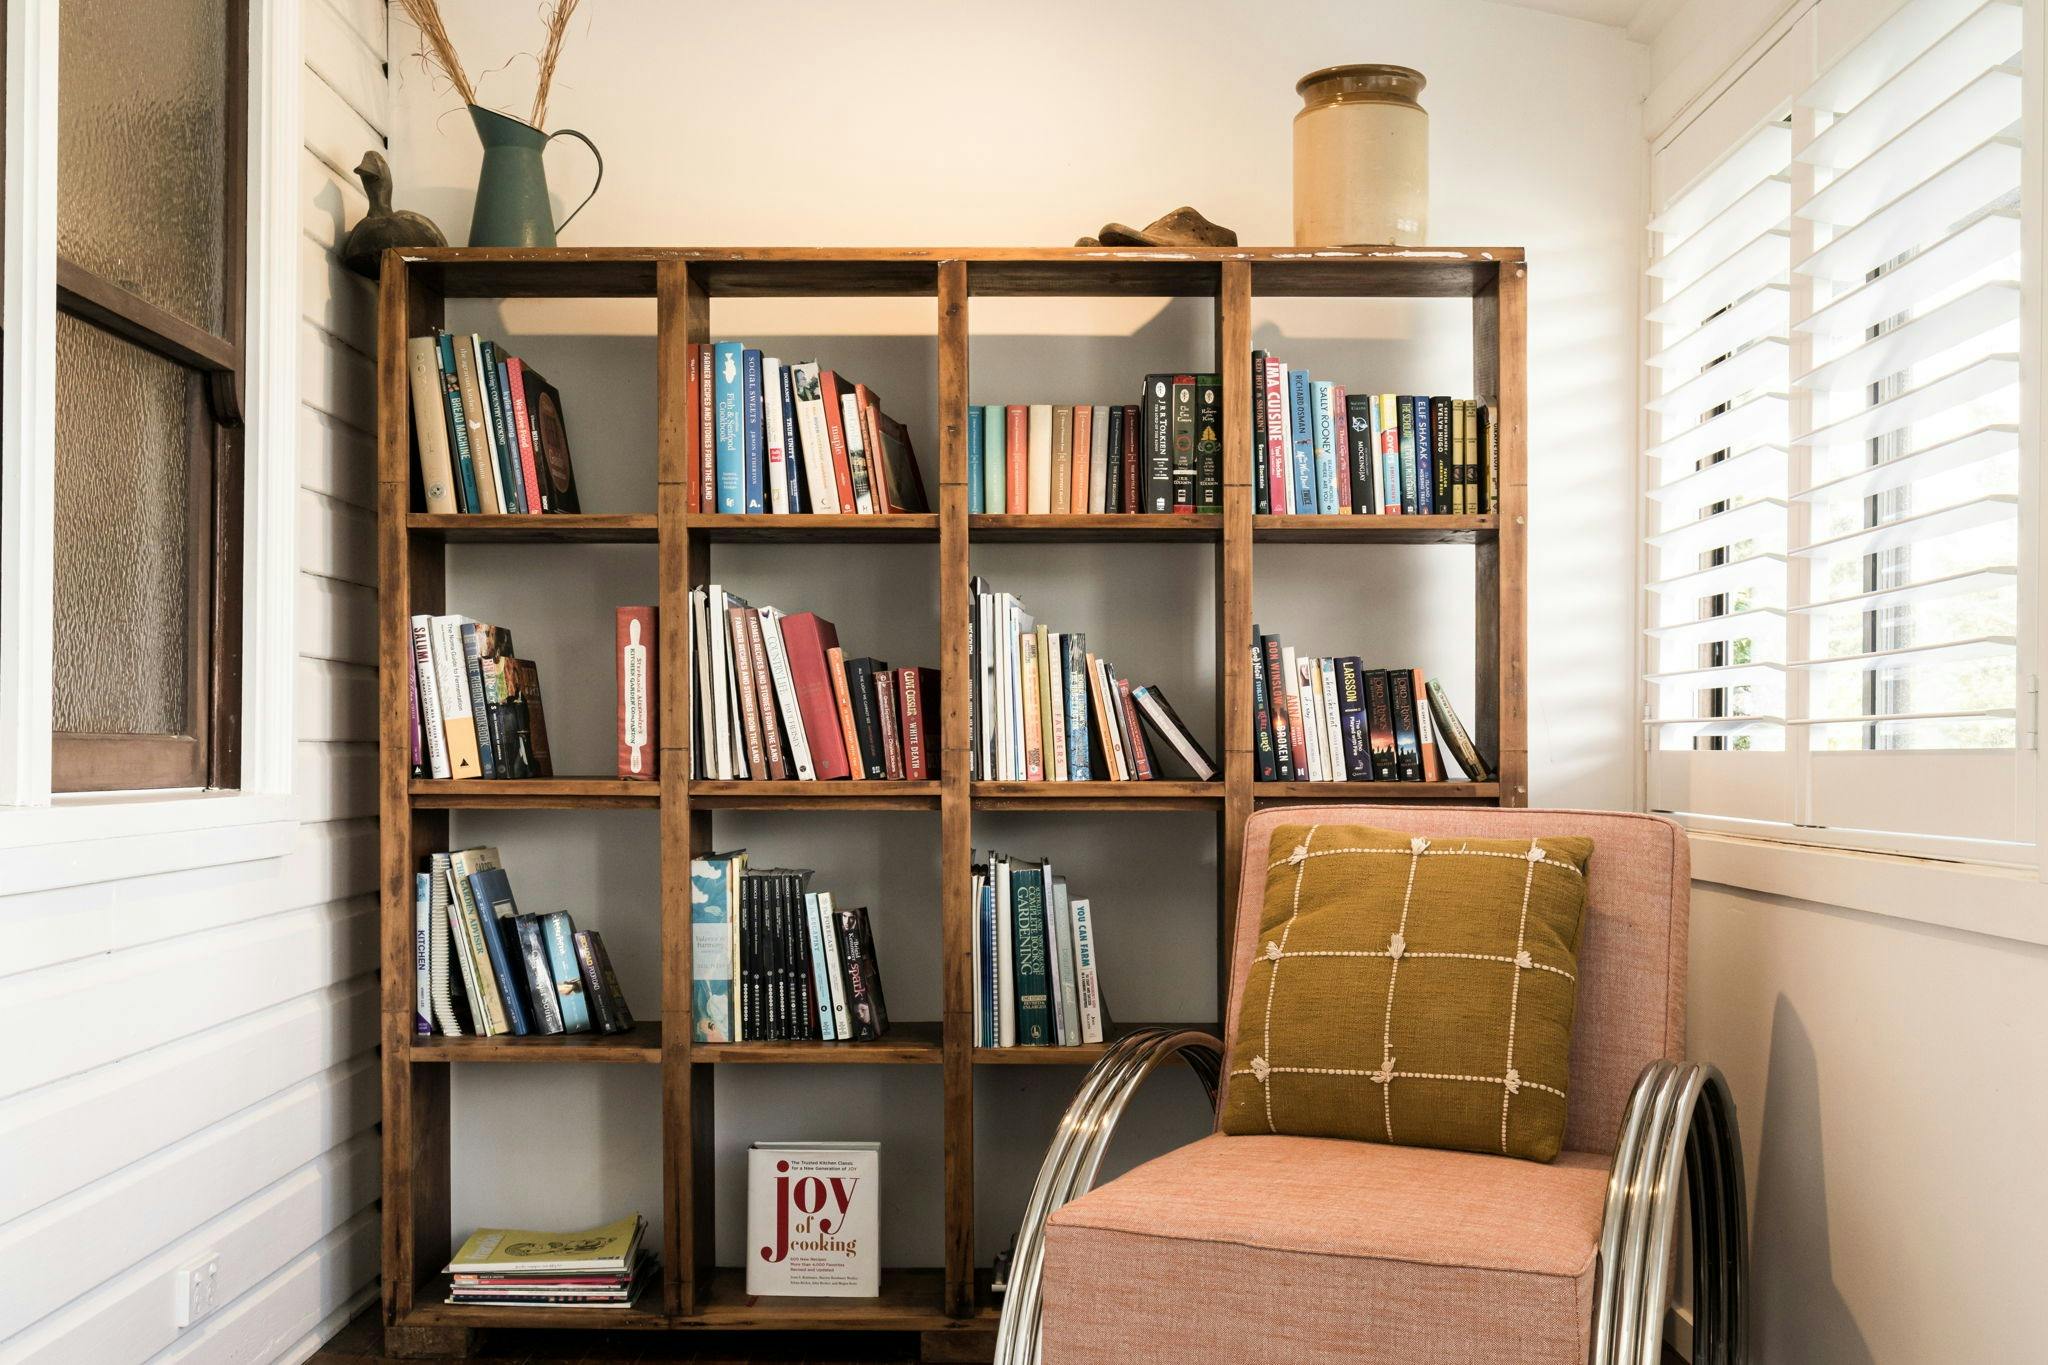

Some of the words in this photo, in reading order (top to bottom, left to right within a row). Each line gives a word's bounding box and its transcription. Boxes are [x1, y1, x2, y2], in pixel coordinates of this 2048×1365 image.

[1266, 362, 1279, 387] IMA
[502, 391, 511, 409] kylie
[727, 393, 735, 409] Fish
[1295, 375, 1304, 405] RICHARD
[1320, 387, 1329, 411] SALLY
[451, 397, 463, 422] BREAD
[516, 399, 524, 410] We
[1268, 392, 1282, 441] CUISINE
[1418, 401, 1426, 419] ELIF
[497, 419, 505, 445] COOKING
[506, 412, 514, 437] kwong
[518, 412, 527, 427] Love
[455, 425, 470, 459] MACHINE
[520, 430, 528, 448] Food
[727, 419, 736, 451] Seafood
[831, 424, 844, 456] maple
[1160, 420, 1168, 455] TOLKIEN
[1321, 415, 1330, 454] ROONEY
[1419, 422, 1427, 459] SHAFAK
[735, 617, 743, 642] FARMER
[750, 617, 760, 643] FARMER
[414, 627, 429, 664] SALUMI
[738, 644, 747, 670] RECIPES
[753, 644, 763, 670] RECIPES
[1268, 641, 1278, 660] DON
[450, 652, 458, 667] Guide
[454, 675, 463, 711] Fermentation
[472, 675, 484, 703] RIBBON
[904, 671, 914, 689] CLIVE
[1270, 662, 1283, 705] WINSLOW
[1343, 662, 1357, 702] LARSSON
[744, 686, 753, 712] STORIES
[760, 685, 769, 711] STORIES
[905, 690, 917, 716] CUSSLER
[1287, 694, 1300, 722] ANNA
[476, 706, 489, 747] COOKBOOK
[909, 723, 918, 745] WHITE
[1055, 713, 1063, 764] FARMERS
[752, 746, 760, 763] LAND
[770, 745, 778, 762] LAND
[1260, 732, 1270, 752] GIRLS
[1276, 725, 1288, 761] BROKEN
[910, 746, 919, 769] DEATH
[455, 861, 465, 877] THE
[459, 880, 473, 915] GARDEN
[1028, 886, 1037, 934] COMPLETE
[1077, 905, 1085, 922] YOU
[469, 918, 483, 955] ADVISER
[1016, 886, 1032, 975] GARDENING
[1079, 925, 1087, 941] CAN
[417, 930, 425, 970] KITCHEN
[1030, 936, 1038, 960] BOOK
[1080, 944, 1090, 967] FARM
[848, 963, 865, 998] spark
[1032, 962, 1040, 975] OF
[760, 1160, 860, 1263] joy
[795, 1215, 814, 1234] of
[790, 1232, 857, 1258] cooking
